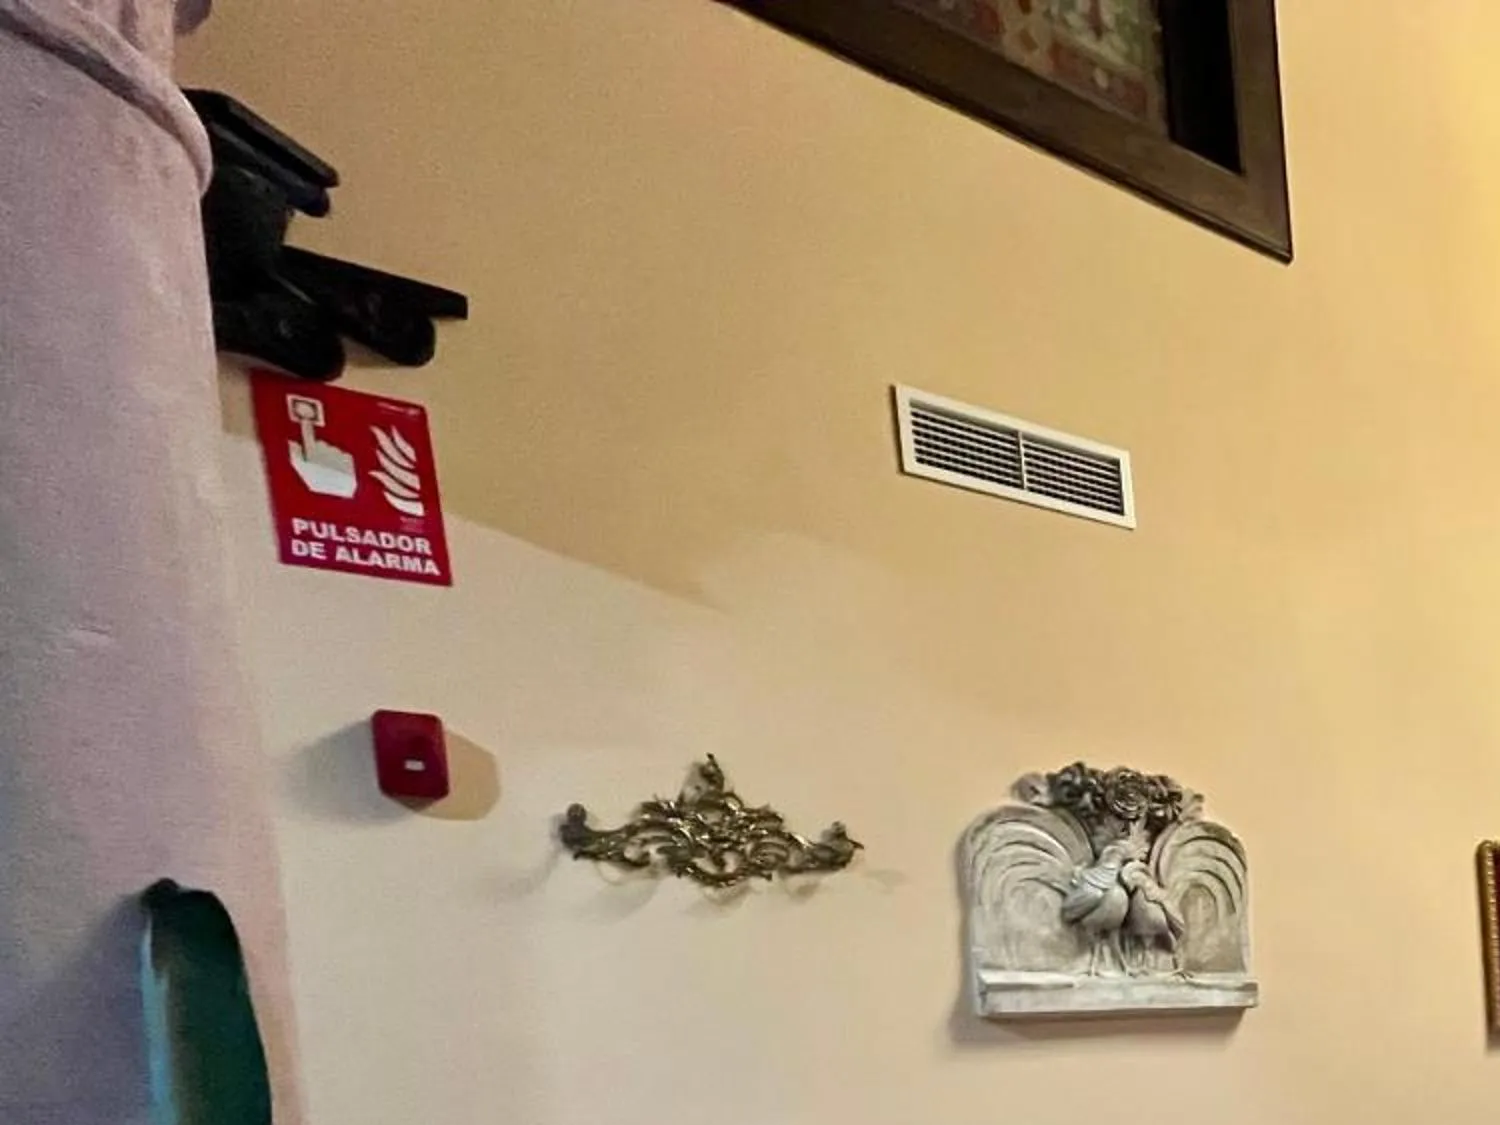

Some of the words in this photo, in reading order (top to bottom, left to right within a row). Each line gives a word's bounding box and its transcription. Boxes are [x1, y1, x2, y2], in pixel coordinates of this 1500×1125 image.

[291, 517, 432, 556] PULSADOR
[291, 538, 327, 560] DE
[335, 545, 440, 576] ALARMA
